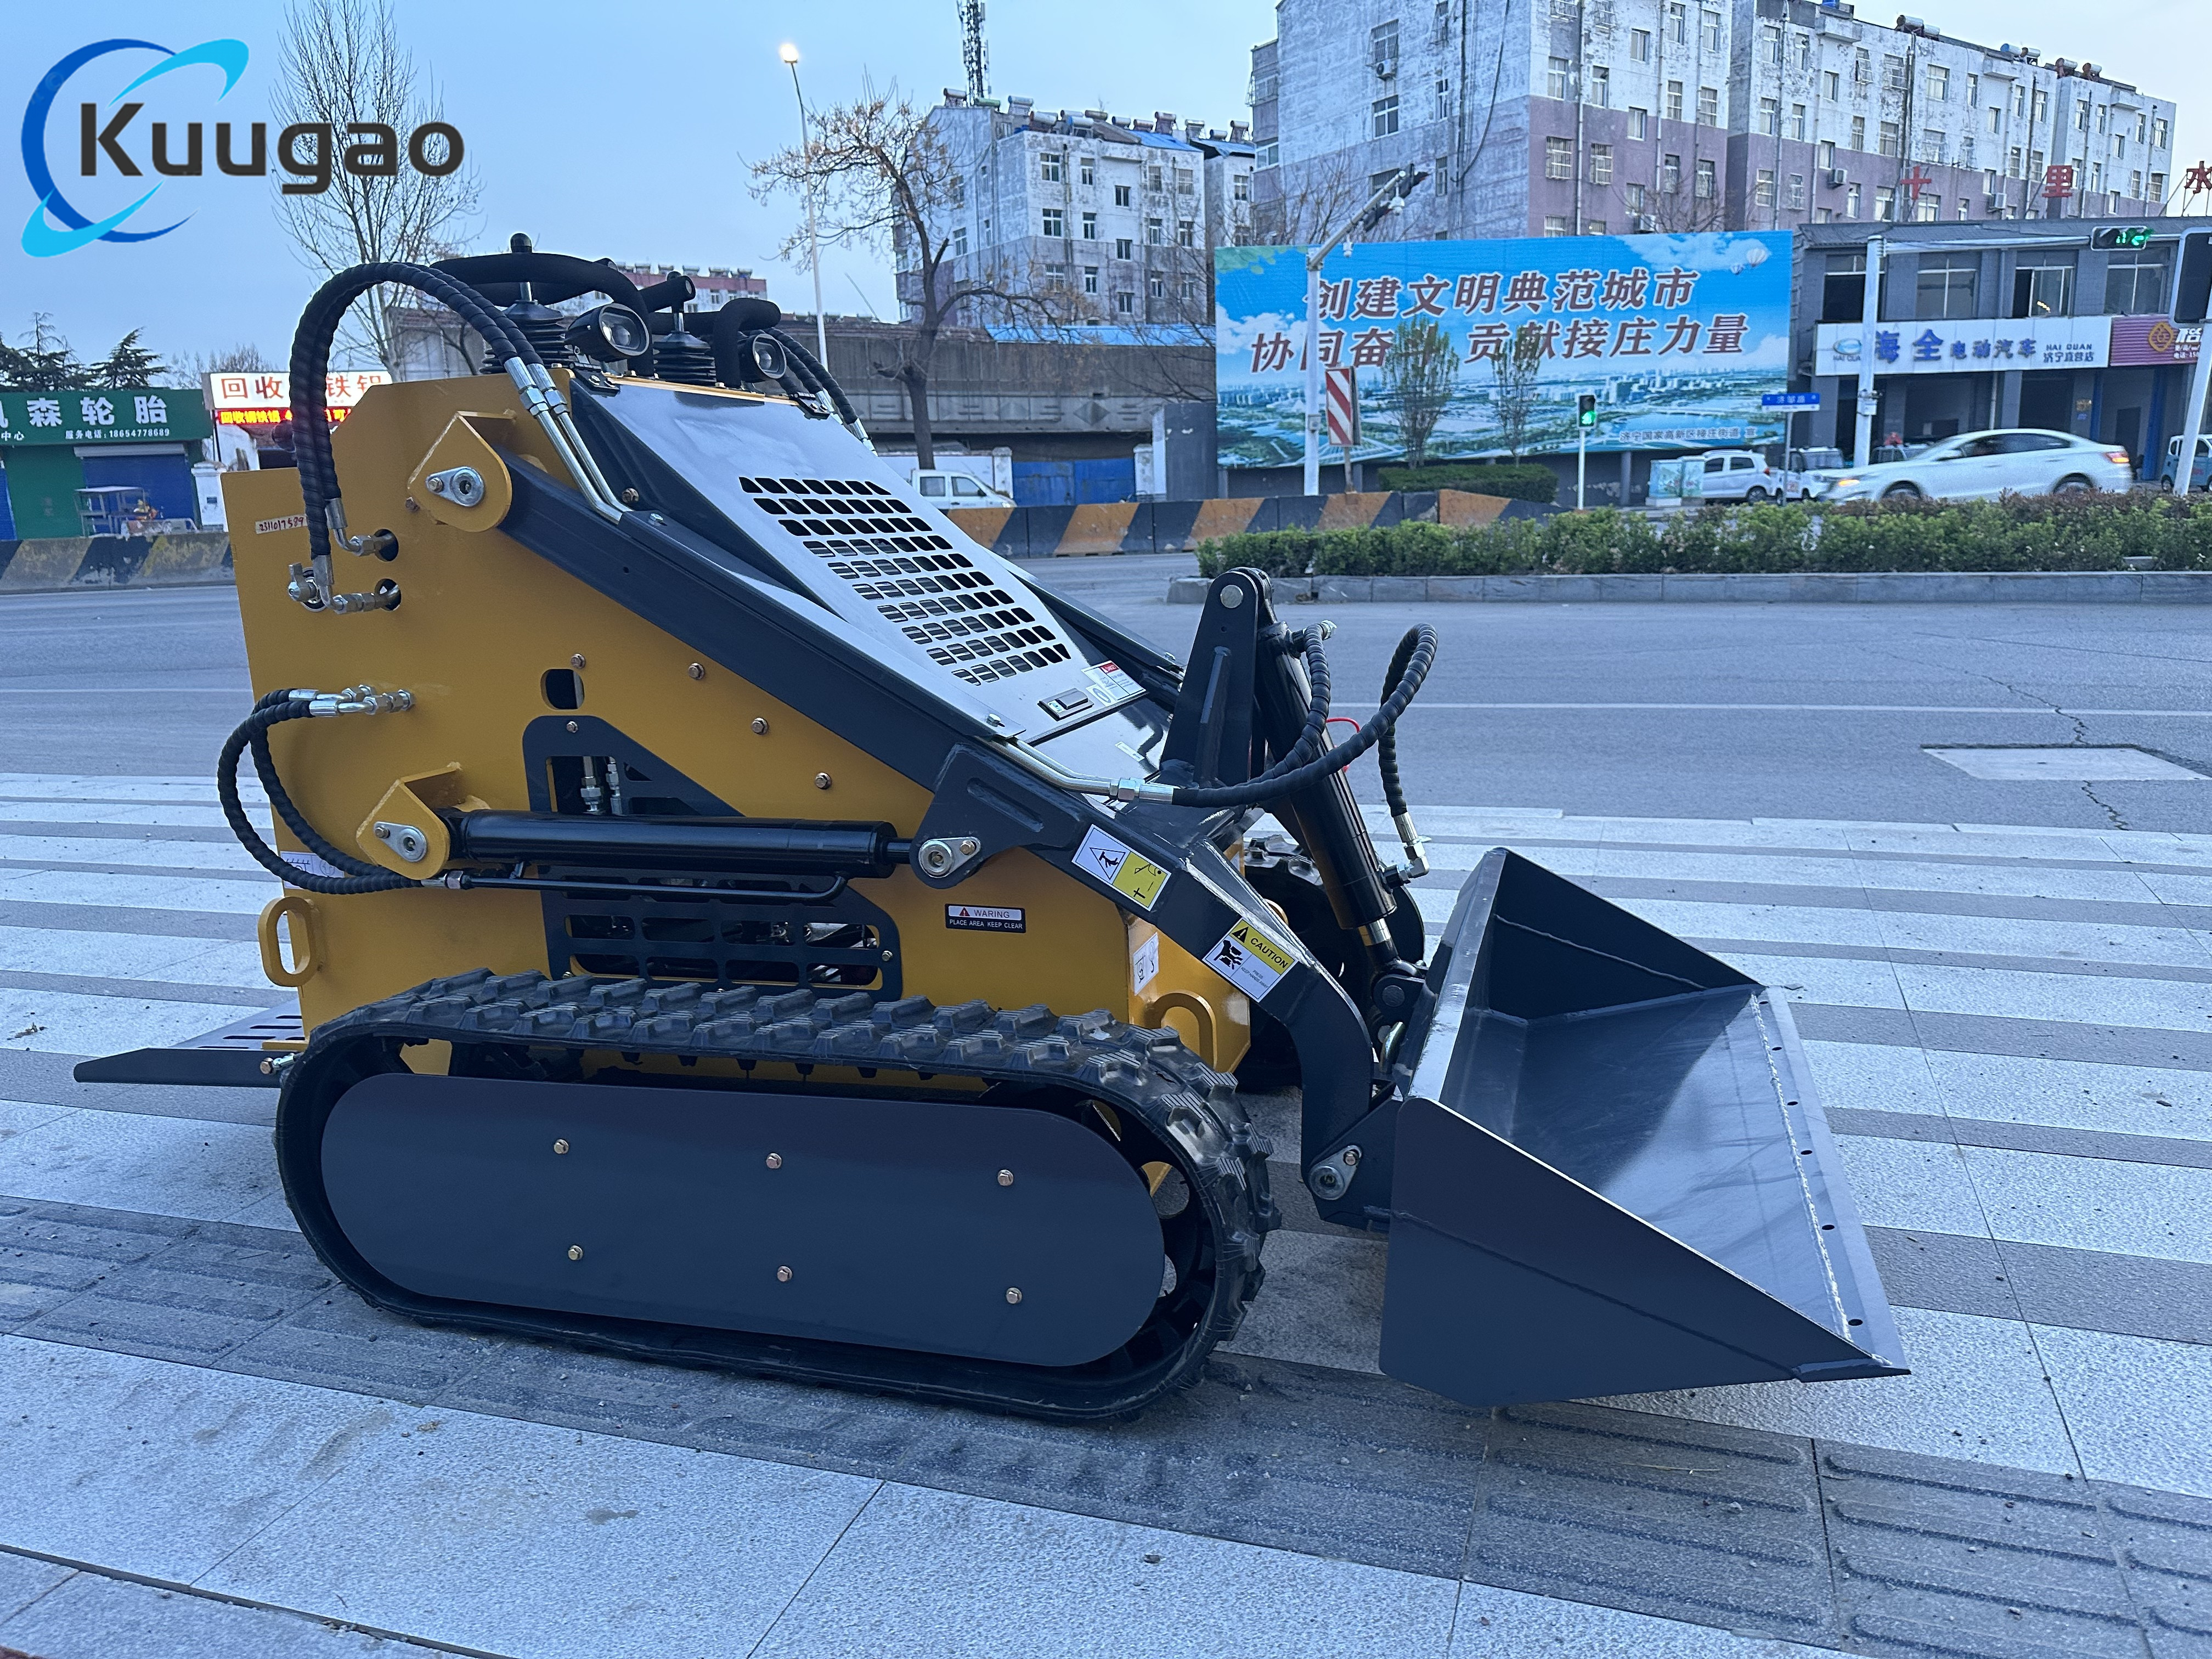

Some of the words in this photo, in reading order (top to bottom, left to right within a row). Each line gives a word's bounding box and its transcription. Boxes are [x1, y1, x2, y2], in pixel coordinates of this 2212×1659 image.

[1304, 268, 1699, 320] 创建文明典范城市
[0, 395, 168, 428] 森轮胎
[973, 909, 1010, 918] WARING
[1250, 938, 1289, 968] CAUTION
